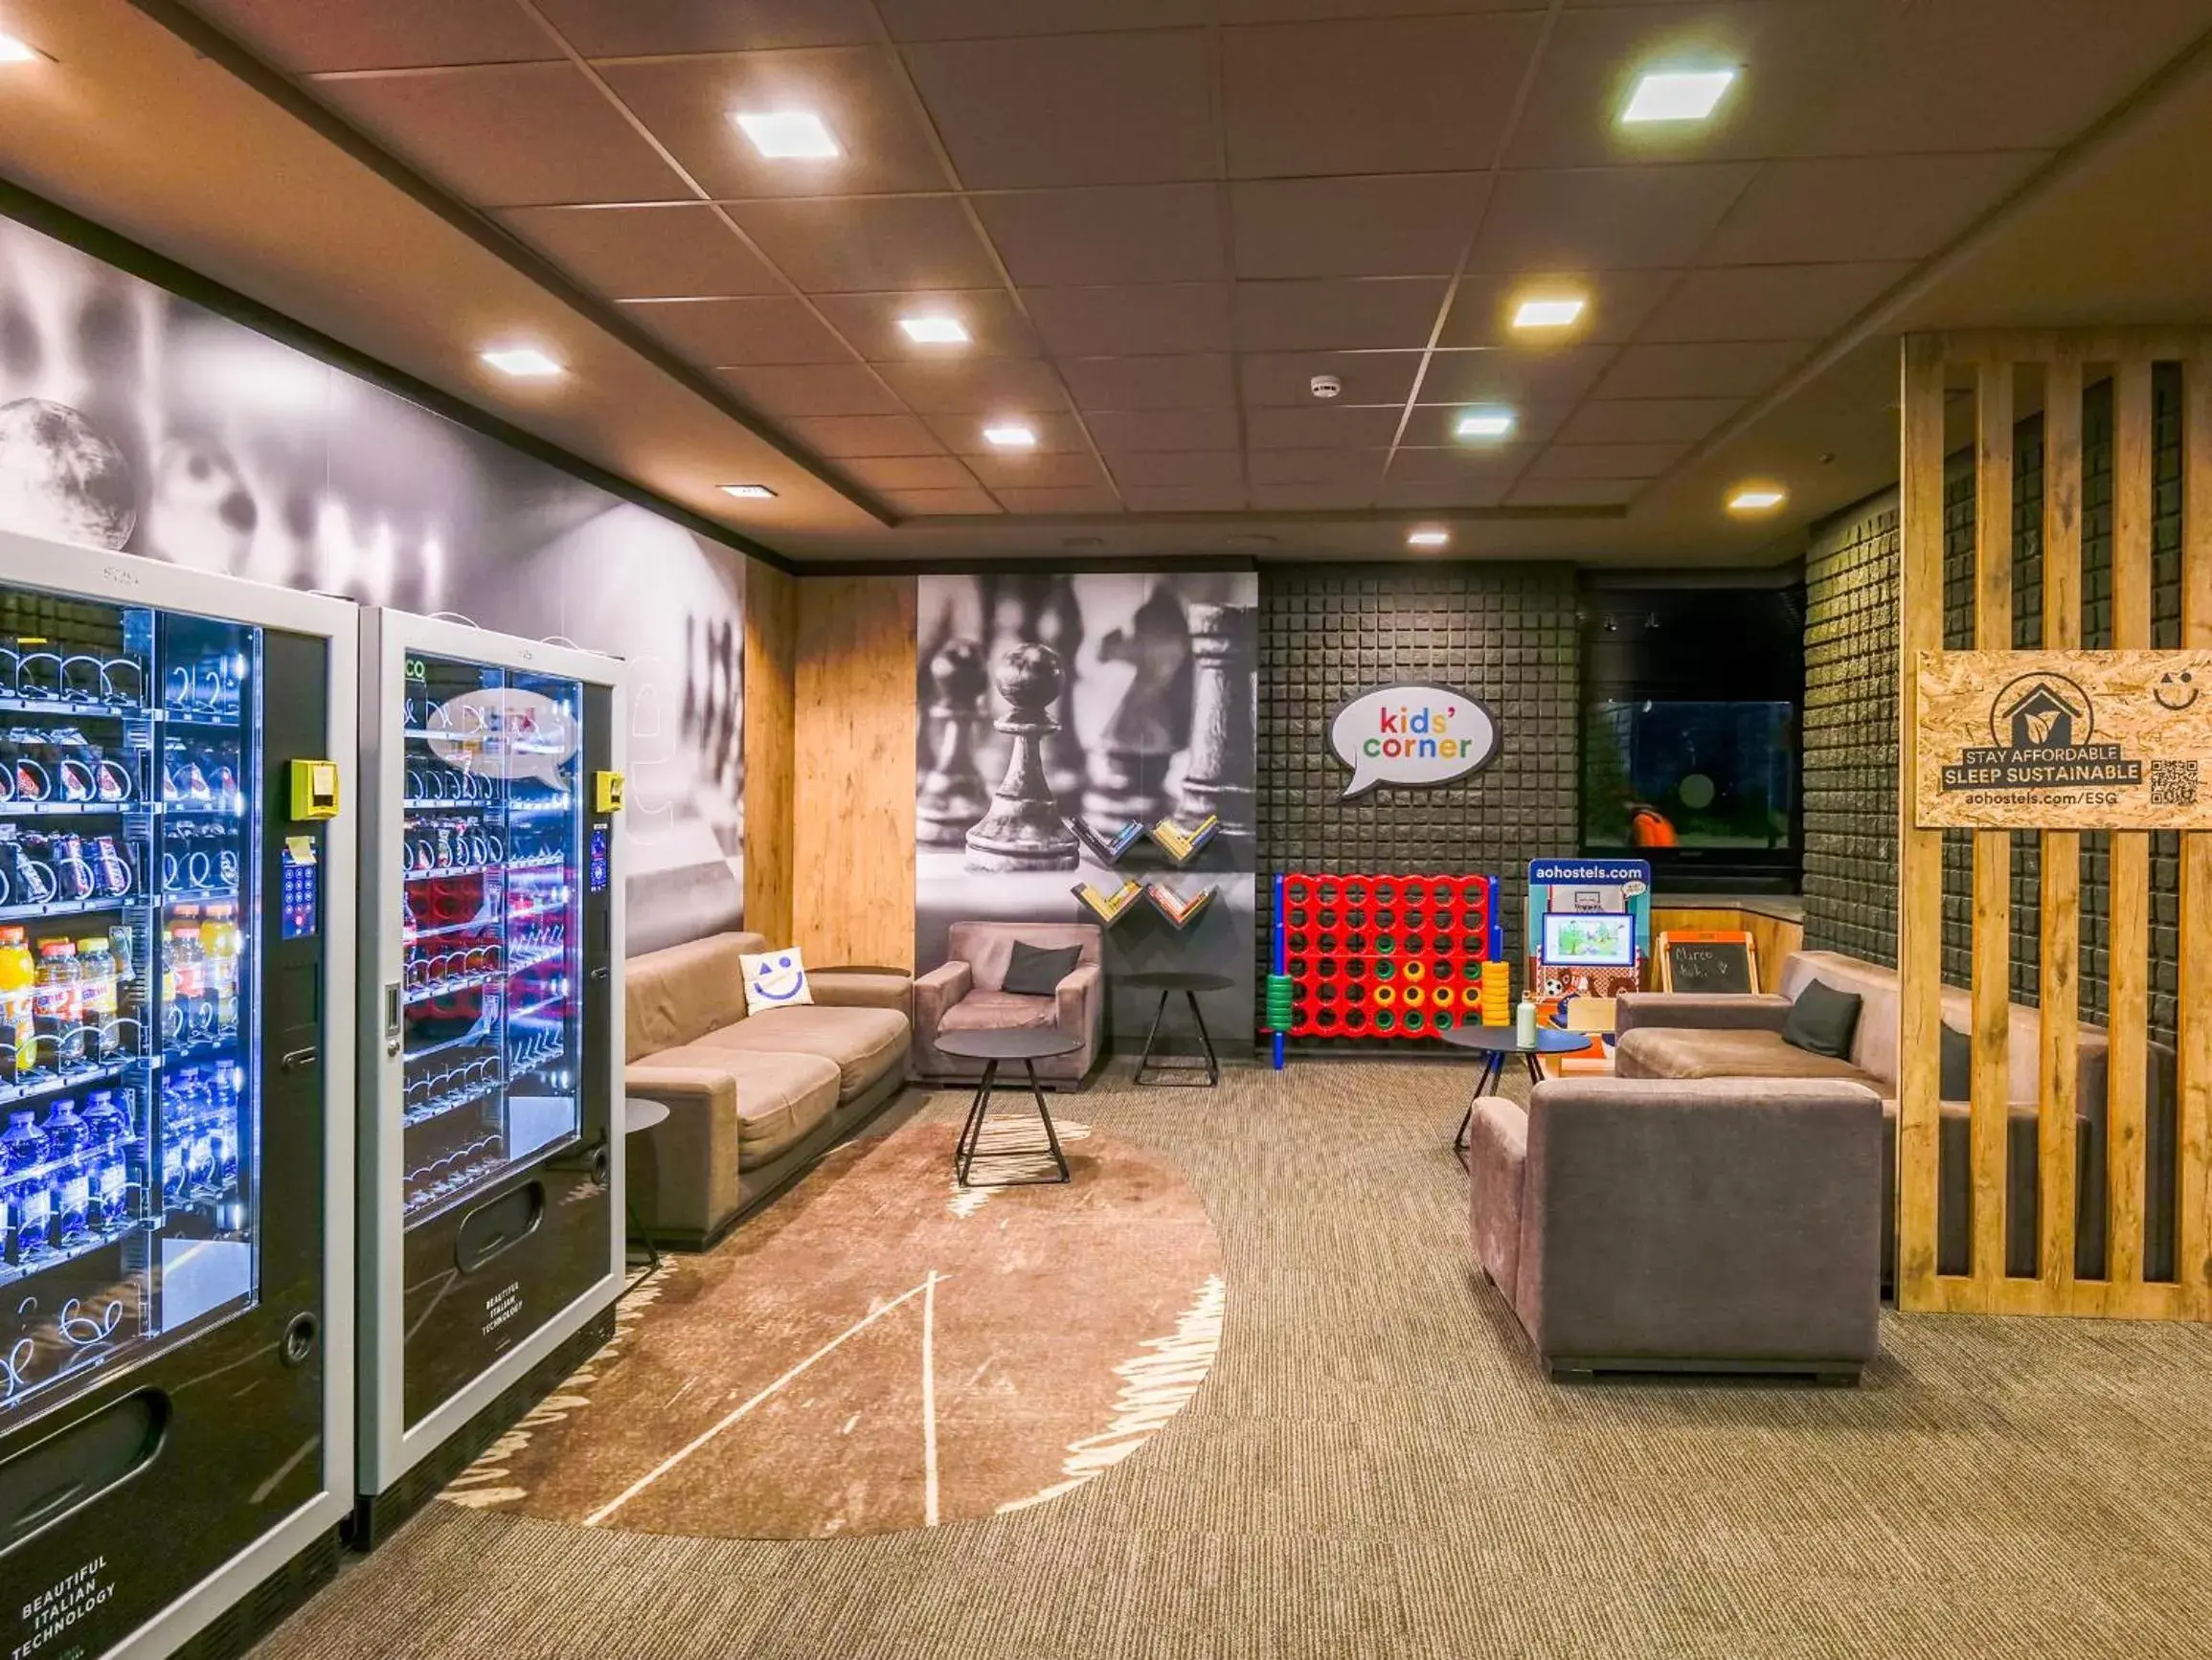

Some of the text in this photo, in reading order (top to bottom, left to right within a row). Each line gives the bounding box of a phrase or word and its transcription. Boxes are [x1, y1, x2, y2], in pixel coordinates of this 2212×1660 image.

[1380, 707, 1456, 734] kids'
[1363, 737, 1473, 759] corner
[1966, 747, 2118, 764] STAY AFFORDABLE
[1945, 763, 2139, 784] SLEEP SUSTAINABLE
[1965, 791, 2118, 805] aohostels.com/ESG
[1535, 864, 1643, 879] aohostels.com
[22, 1555, 107, 1620] BEAUTIFUL
[34, 1578, 96, 1630] ITALIAN
[11, 1581, 116, 1660] TECHNOLOGY
